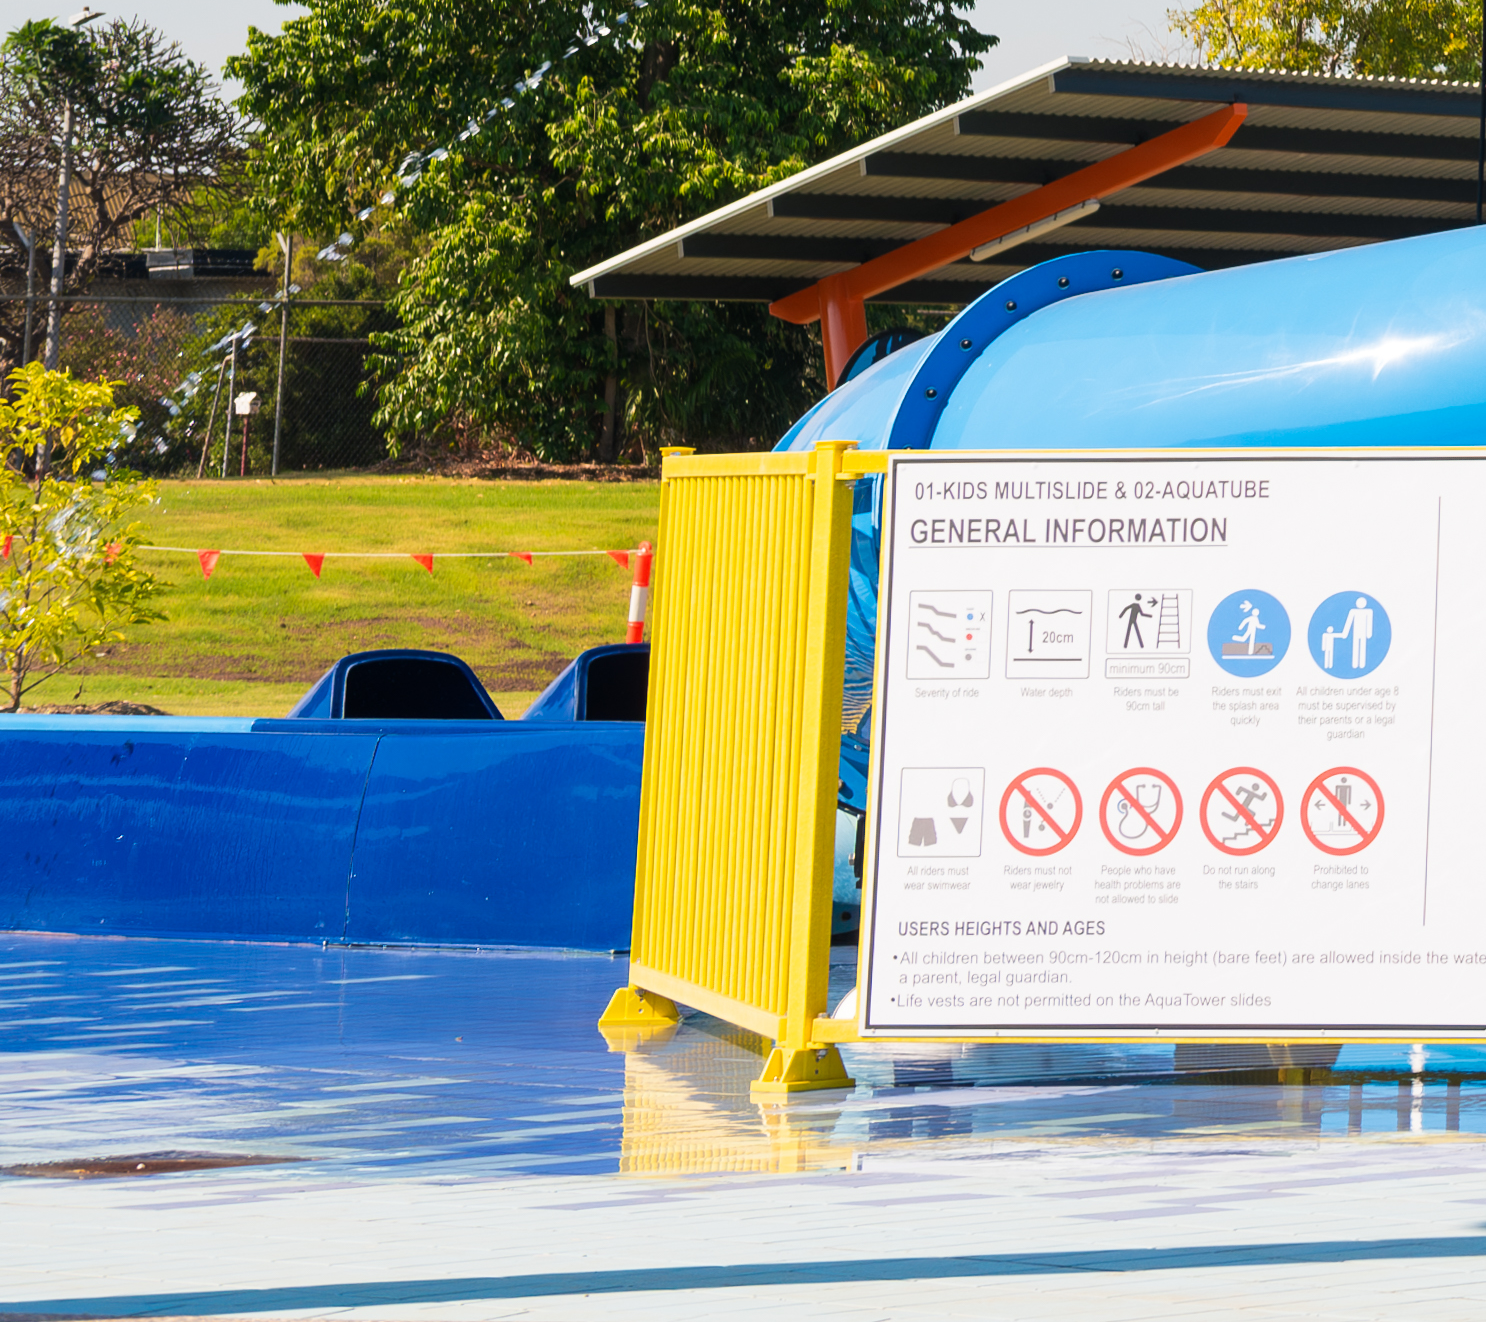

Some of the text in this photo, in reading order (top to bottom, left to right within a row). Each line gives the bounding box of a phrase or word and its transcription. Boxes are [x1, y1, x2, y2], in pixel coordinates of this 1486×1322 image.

[915, 480, 1270, 500] 01-KIDS MULTISLIDE & 02-AQUATUBE
[910, 518, 1227, 543] GENERAL INFORMATION
[1041, 630, 1075, 644] 20cm
[1109, 662, 1186, 674] minimum 90cm
[915, 686, 980, 699] Severity of ride
[1020, 686, 1073, 699] Water depth
[1113, 686, 1180, 697] Riders must be
[1211, 685, 1283, 696] Riders must exit
[1295, 685, 1399, 698] All children under age 8
[1125, 700, 1165, 711] 90cm tall
[1212, 700, 1280, 712] the splash area
[1297, 700, 1397, 712] must be supervised by
[1229, 714, 1261, 727] quickly
[1297, 714, 1396, 727] their parents or a legal
[1325, 728, 1366, 741] guardian
[906, 865, 969, 875] All riders must
[1003, 864, 1073, 875] Riders must not
[1100, 864, 1177, 876] People who have
[1202, 864, 1276, 877] Do not run along
[1313, 864, 1369, 875] Prohibited to
[903, 880, 971, 890] wear swimwear
[1009, 879, 1065, 892] wear jewelry
[1094, 879, 1181, 891] health problems are
[1218, 879, 1259, 889] the stairs
[1310, 878, 1370, 891] change lanes
[1095, 893, 1179, 904] not allowed to slide
[898, 921, 1105, 936] USERS HEIGHTS AND AGES
[922, 952, 979, 964] children
[983, 951, 1044, 964] between
[1049, 951, 1142, 964] 90cm-120cm
[1146, 951, 1159, 963] in
[1163, 951, 1208, 967] height
[1212, 951, 1251, 966] (bare
[1255, 950, 1287, 967] feet)
[1291, 954, 1315, 963] are
[1319, 951, 1375, 963] allowed
[1379, 951, 1422, 964] inside
[1426, 951, 1449, 964] the
[899, 971, 1073, 987] a parent, legal guardian.
[927, 995, 965, 1007] vests
[969, 997, 993, 1007] are
[997, 994, 1021, 1006] not
[1023, 994, 1092, 1009] permitted
[1095, 997, 1114, 1006] on
[1118, 993, 1141, 1006] the
[1229, 993, 1273, 1006] slides
